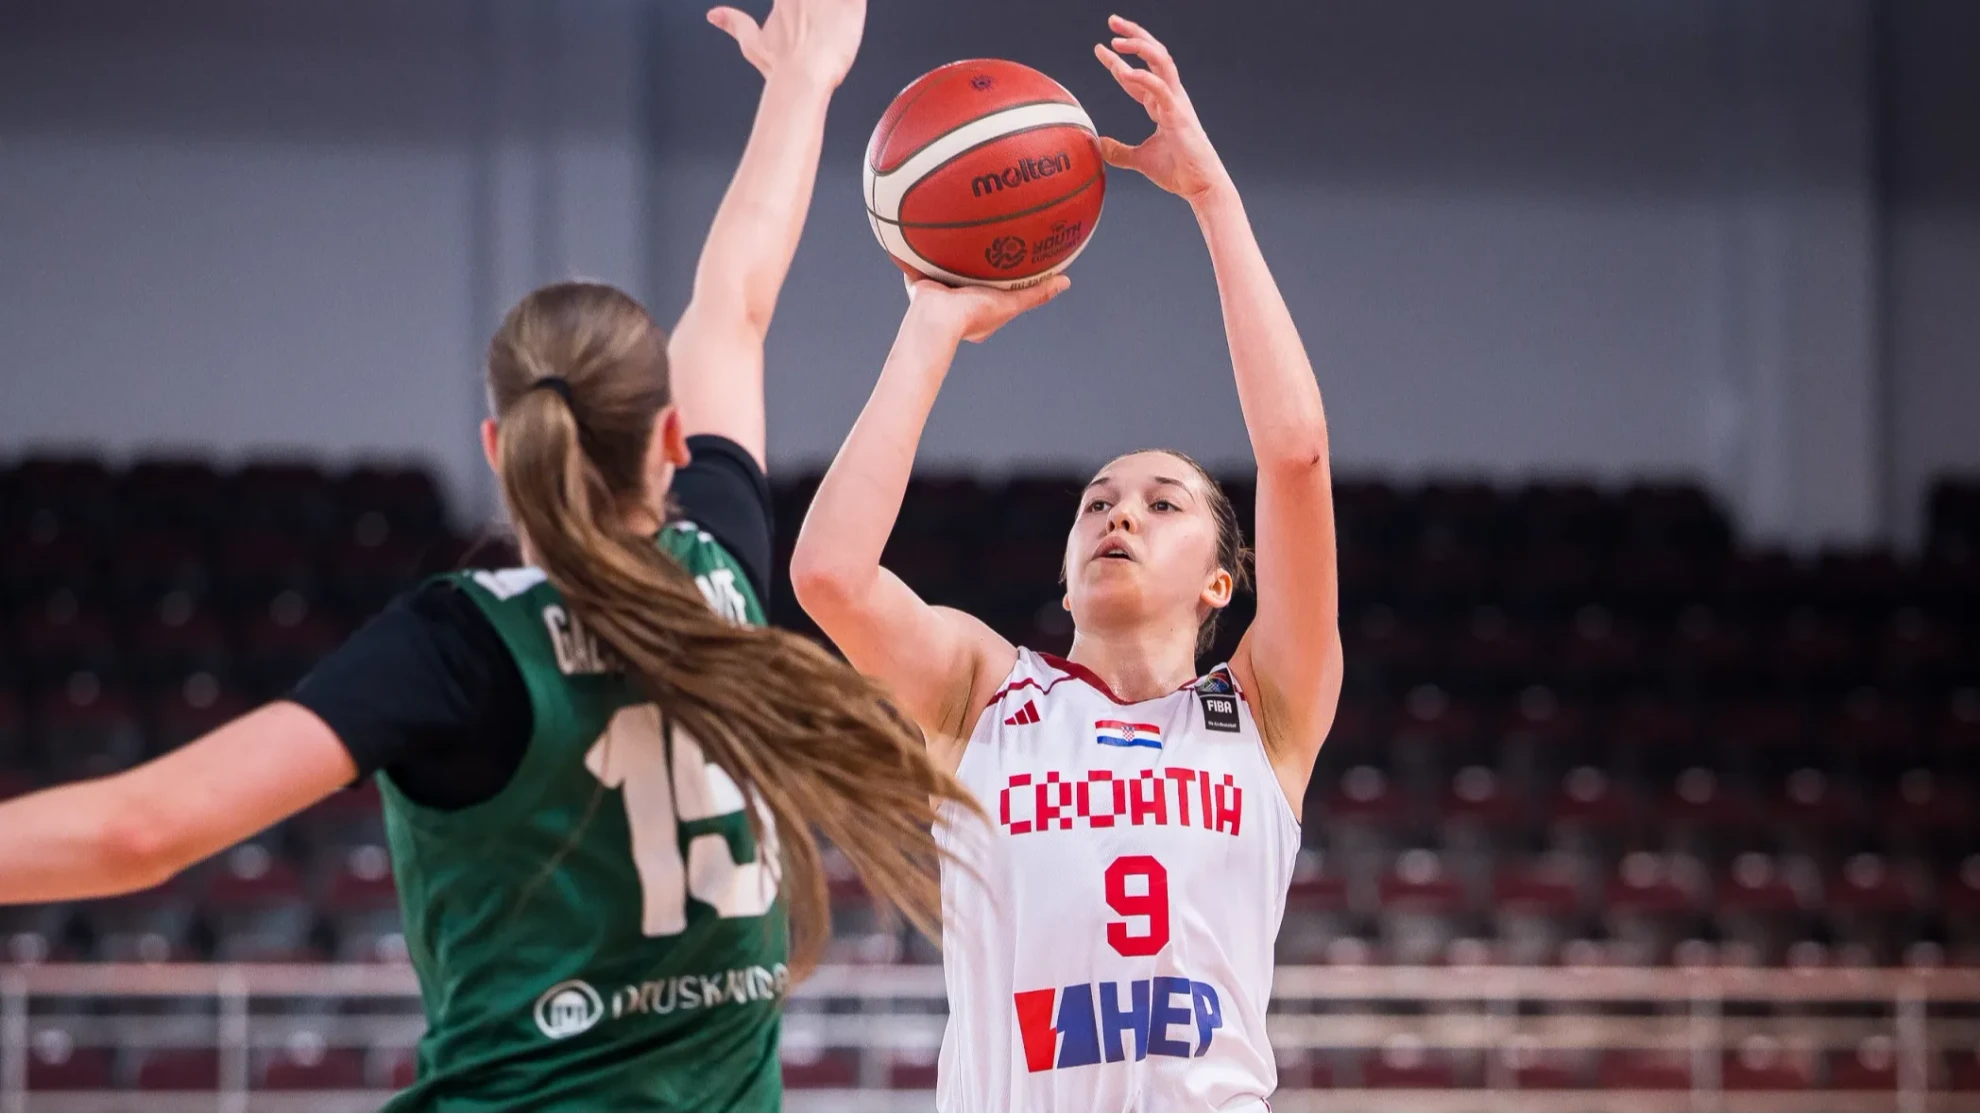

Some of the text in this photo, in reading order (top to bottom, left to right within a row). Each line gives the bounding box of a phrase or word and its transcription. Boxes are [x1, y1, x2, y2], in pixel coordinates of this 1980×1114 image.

[971, 151, 1071, 198] molten
[1206, 699, 1233, 714] FIBA
[1000, 767, 1242, 836] CROATIA
[1104, 855, 1170, 957] 9
[1099, 975, 1223, 1063] HEP
